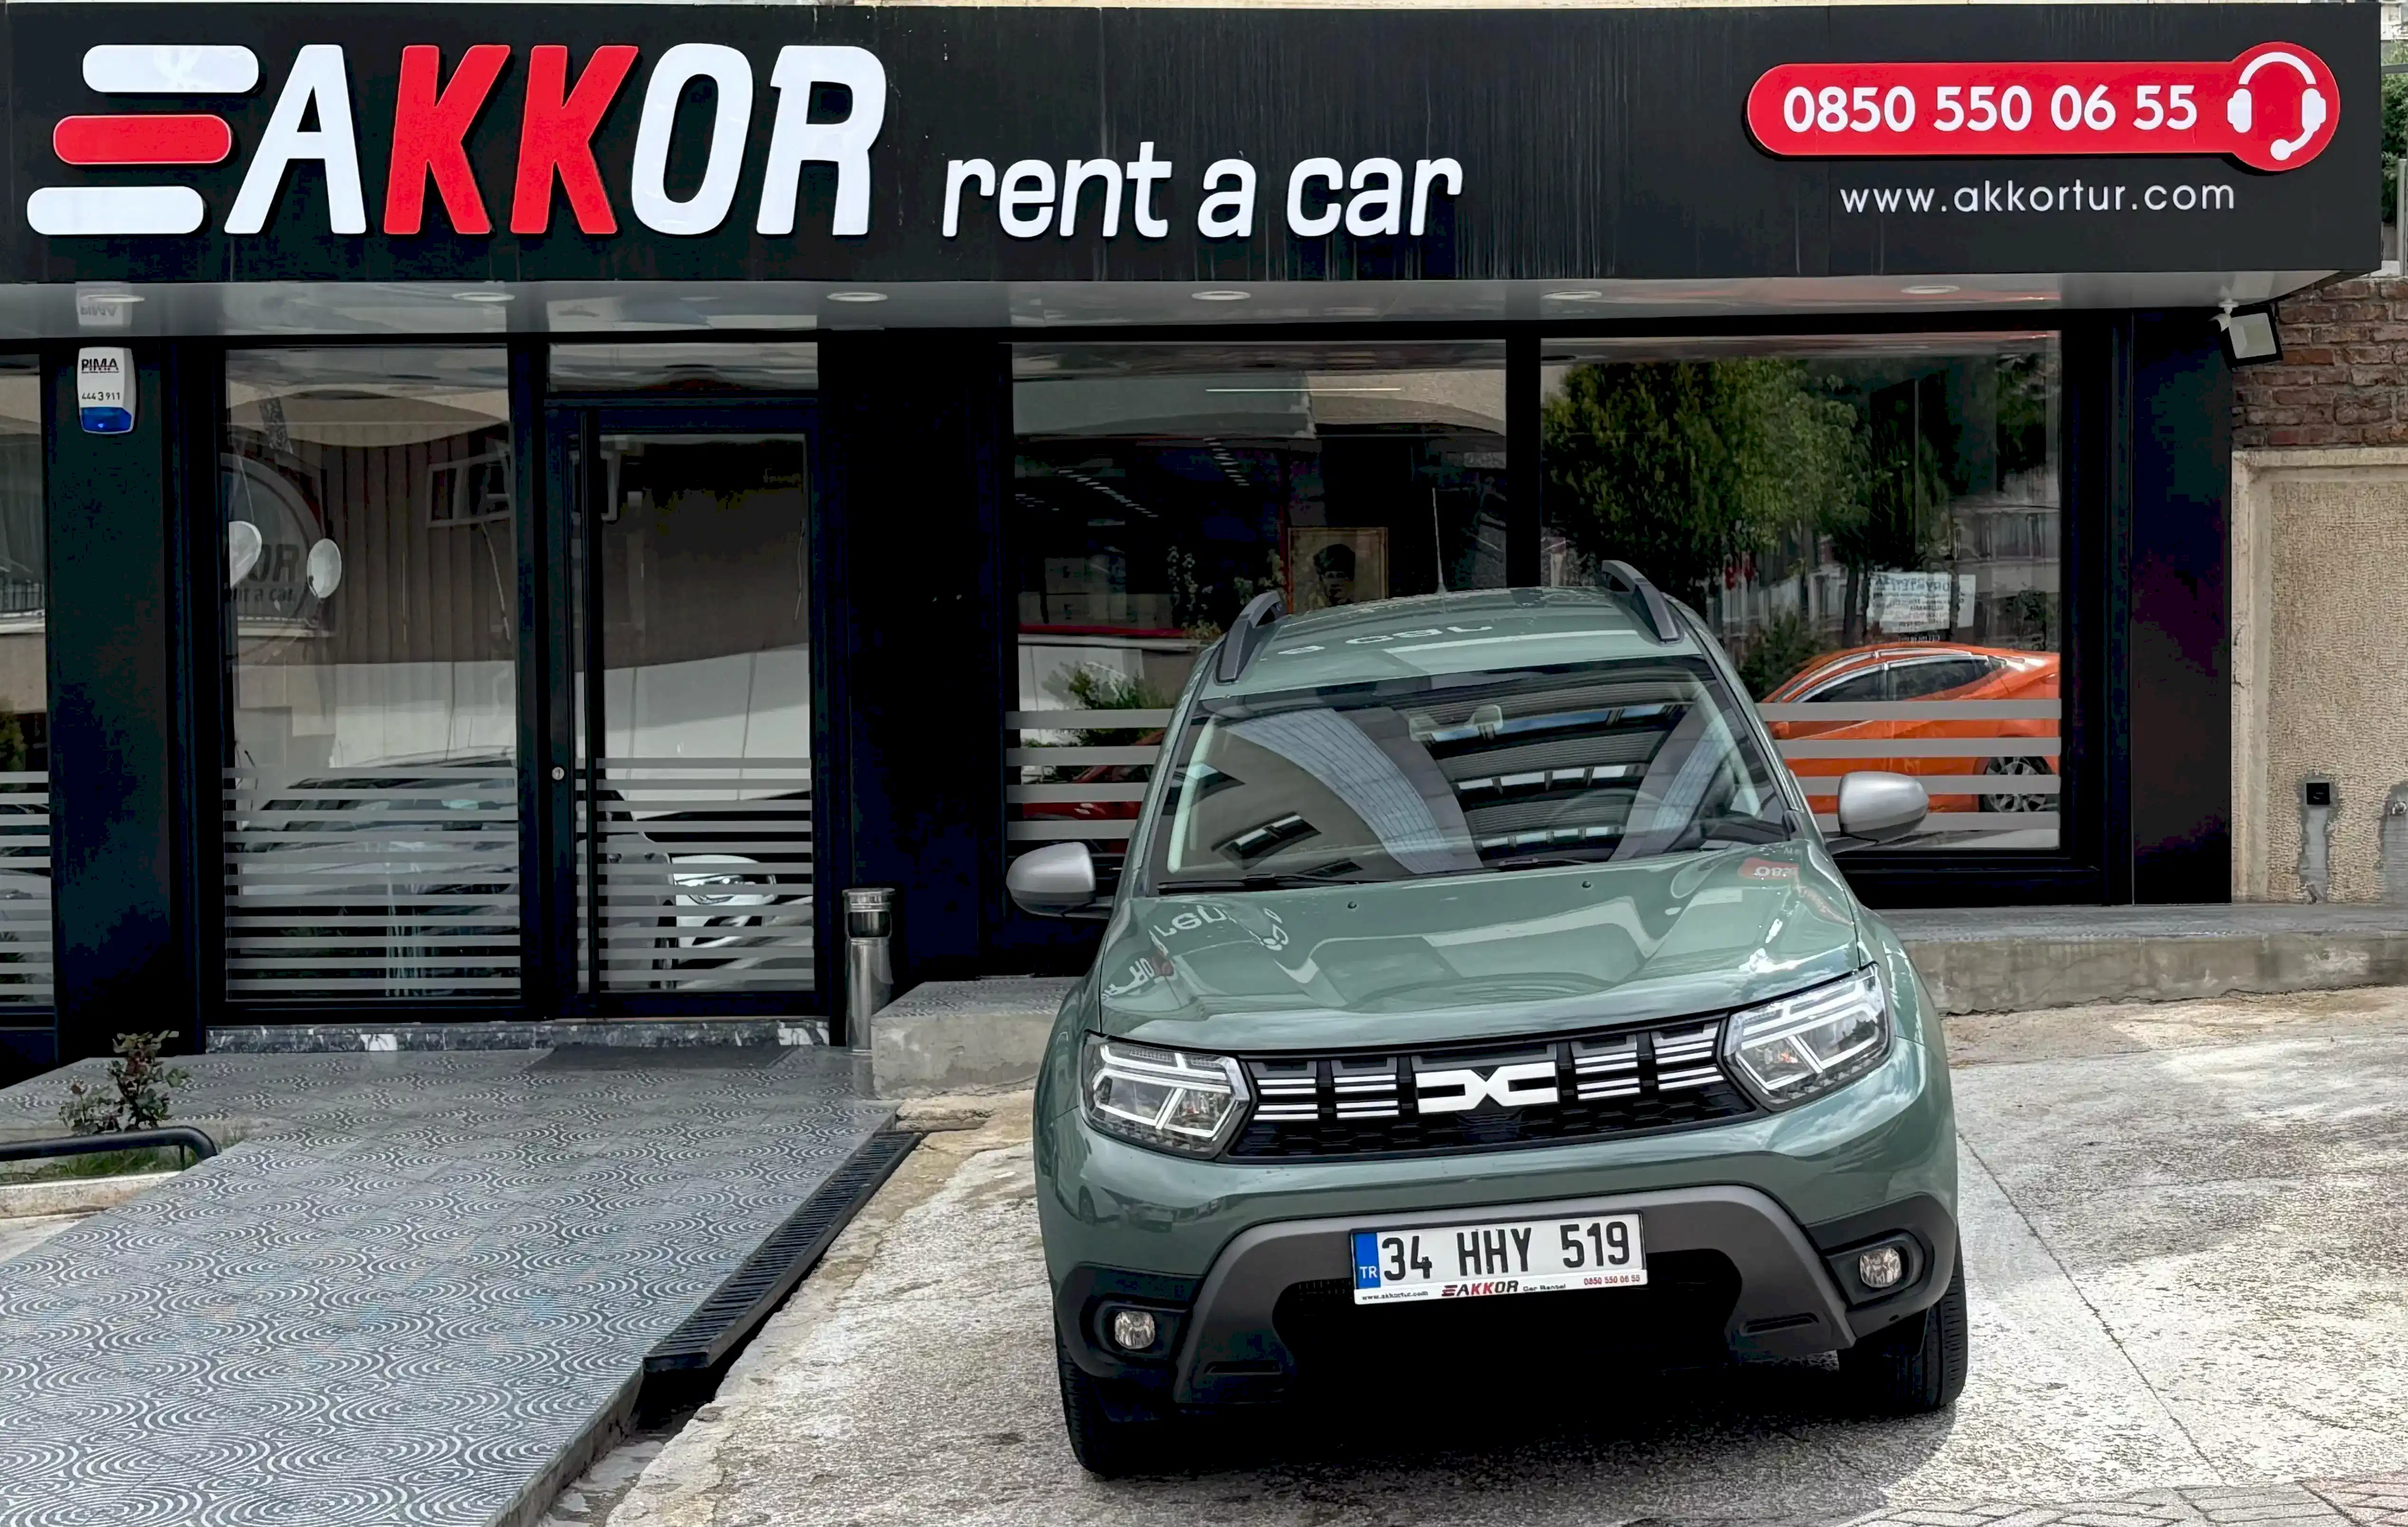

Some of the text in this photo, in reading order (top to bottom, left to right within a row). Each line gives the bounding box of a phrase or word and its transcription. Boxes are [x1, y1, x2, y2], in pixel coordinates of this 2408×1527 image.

[1784, 84, 2197, 133] 0850 550 06 55
[224, 43, 1462, 238] AKKOR rent a car
[1840, 179, 2234, 212] www.akkortur.com
[81, 358, 119, 372] PIMA
[98, 391, 104, 402] 3
[105, 392, 121, 401] 911
[1359, 1221, 1630, 1281] TR 34 HHY 519
[1456, 1280, 1519, 1297] AKKOR
[1584, 1277, 1602, 1286] 0850
[1605, 1276, 1618, 1284] 550
